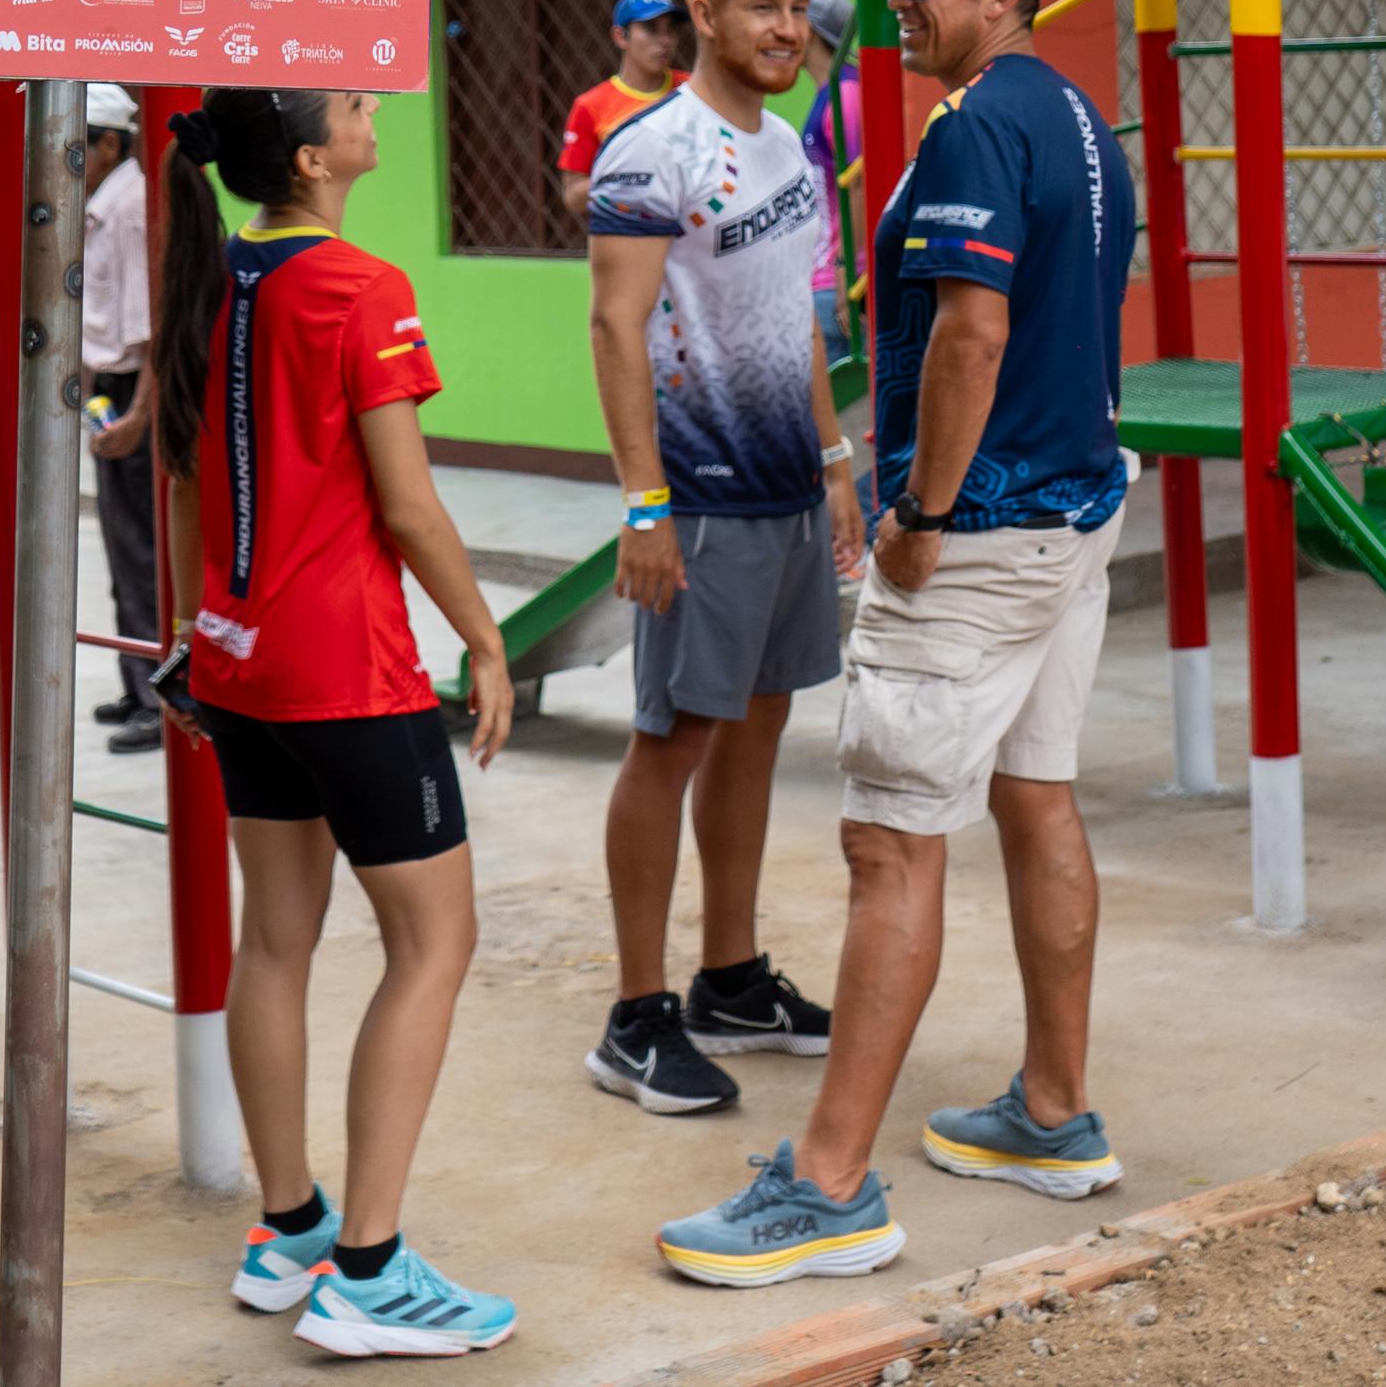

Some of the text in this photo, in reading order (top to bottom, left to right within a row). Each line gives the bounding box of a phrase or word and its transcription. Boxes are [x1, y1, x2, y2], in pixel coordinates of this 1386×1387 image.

[27, 34, 65, 52] Bita
[223, 41, 259, 56] Cris
[751, 1214, 819, 1246] HOKA
